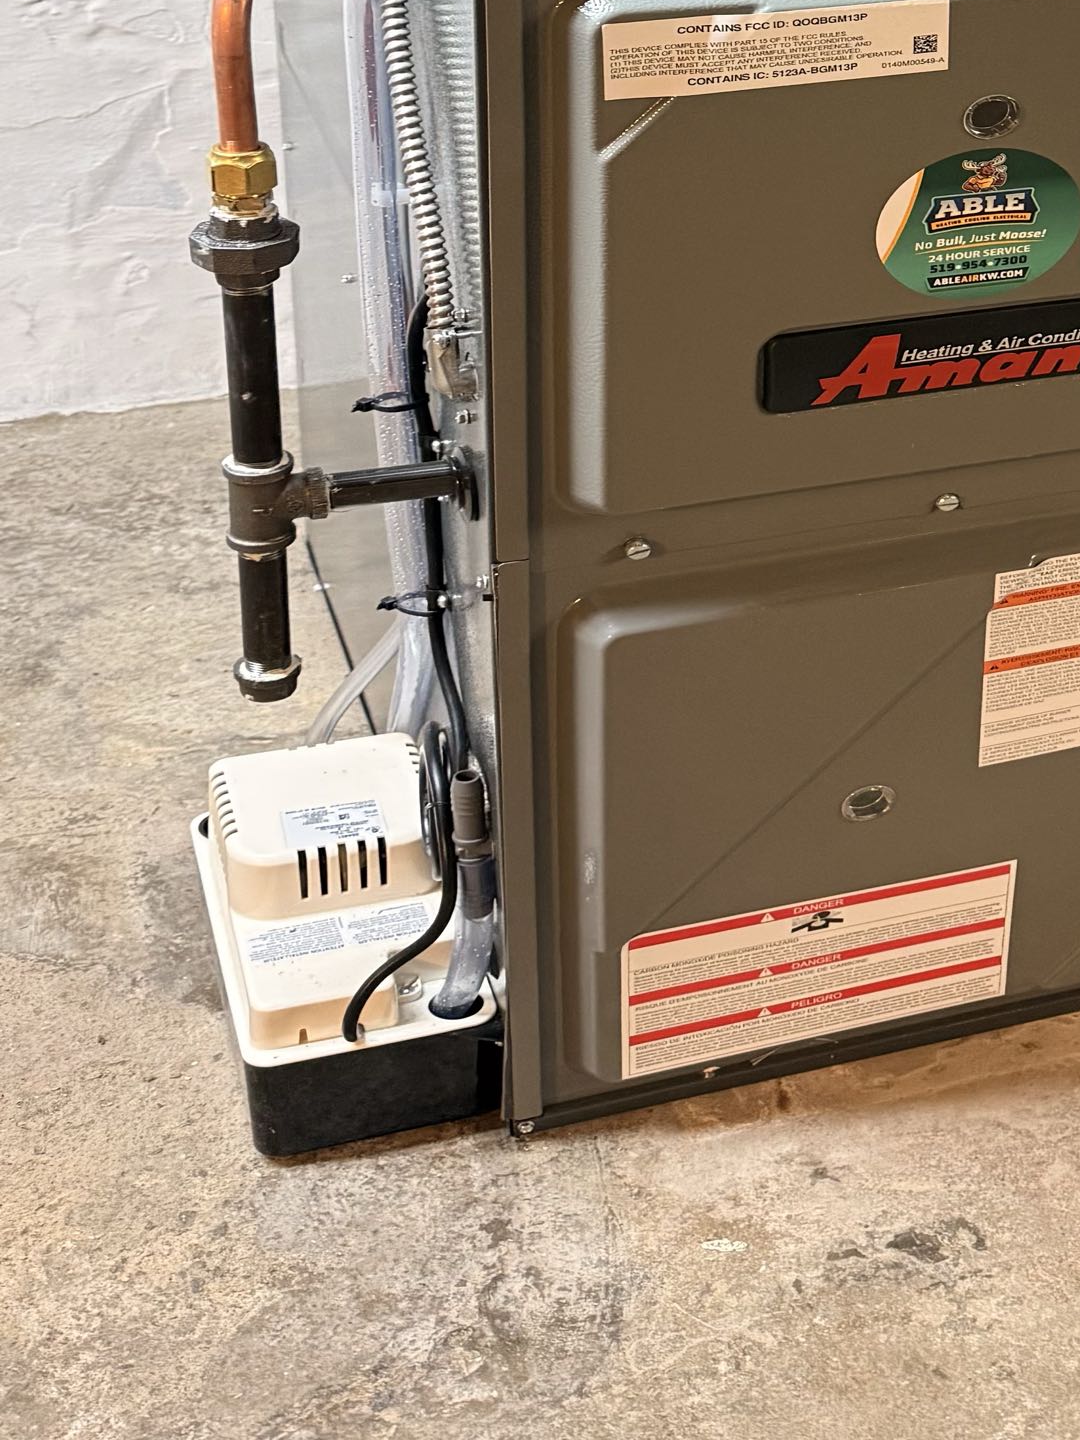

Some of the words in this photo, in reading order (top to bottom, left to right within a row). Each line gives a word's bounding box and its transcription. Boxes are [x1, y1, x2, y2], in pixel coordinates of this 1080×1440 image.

[677, 22, 742, 35] CONTAINS
[745, 21, 770, 31] FCC
[773, 20, 790, 29] ID:
[687, 73, 751, 86] CONTAINS
[754, 72, 769, 81] IC:
[772, 62, 858, 78] 5123A-BGM13P
[935, 193, 1025, 219] ABLE
[915, 241, 932, 251] No
[936, 236, 966, 248] Bull,
[969, 234, 996, 243] Just
[999, 229, 1047, 240] Moose!
[928, 254, 944, 263] 24
[946, 250, 980, 260] HOUR
[983, 245, 1031, 257] SERVICE
[933, 269, 1023, 286] ABLEAIRKW.COM
[900, 340, 974, 364] Heating
[978, 339, 993, 351] &
[996, 335, 1025, 350] Air
[793, 898, 844, 915] DANGER
[791, 952, 842, 969] DANGER
[790, 991, 843, 1009] PELIGRO
